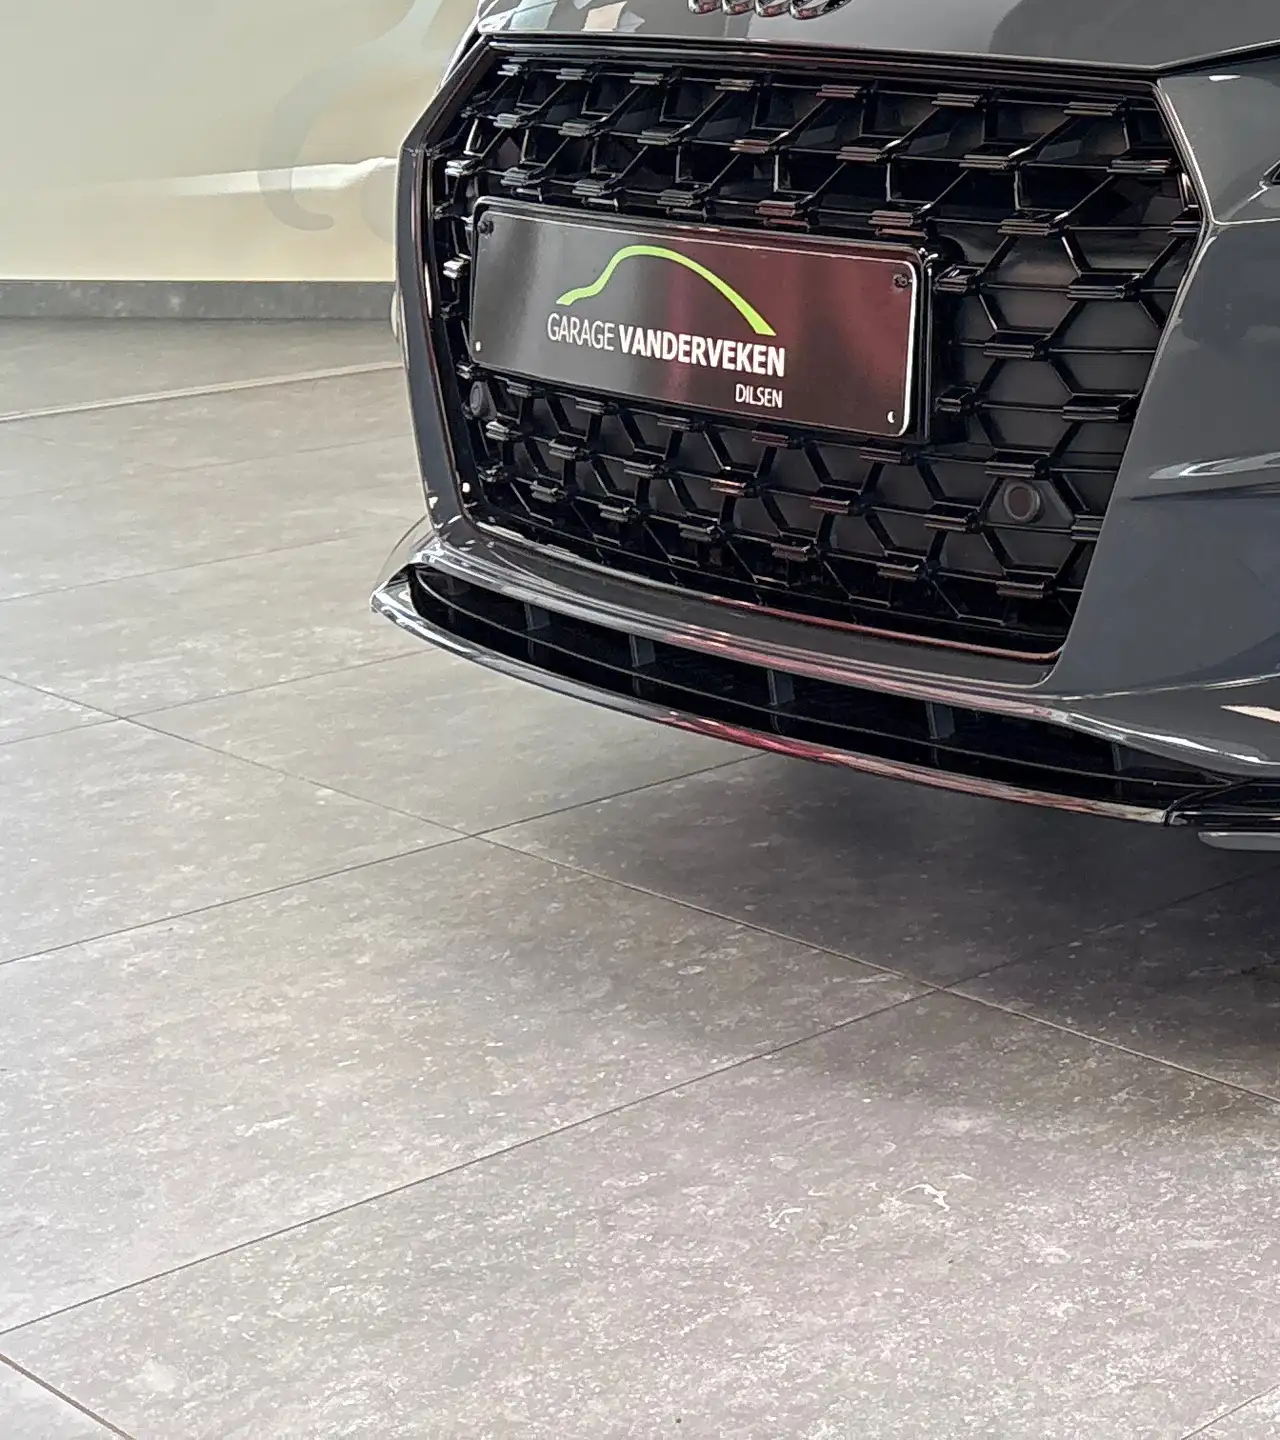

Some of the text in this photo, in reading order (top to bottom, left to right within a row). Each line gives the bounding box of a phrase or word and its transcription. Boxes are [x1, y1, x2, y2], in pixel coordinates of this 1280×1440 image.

[547, 312, 786, 377] GARAGE VANDERVEKEN
[735, 383, 784, 409] DILSEN
